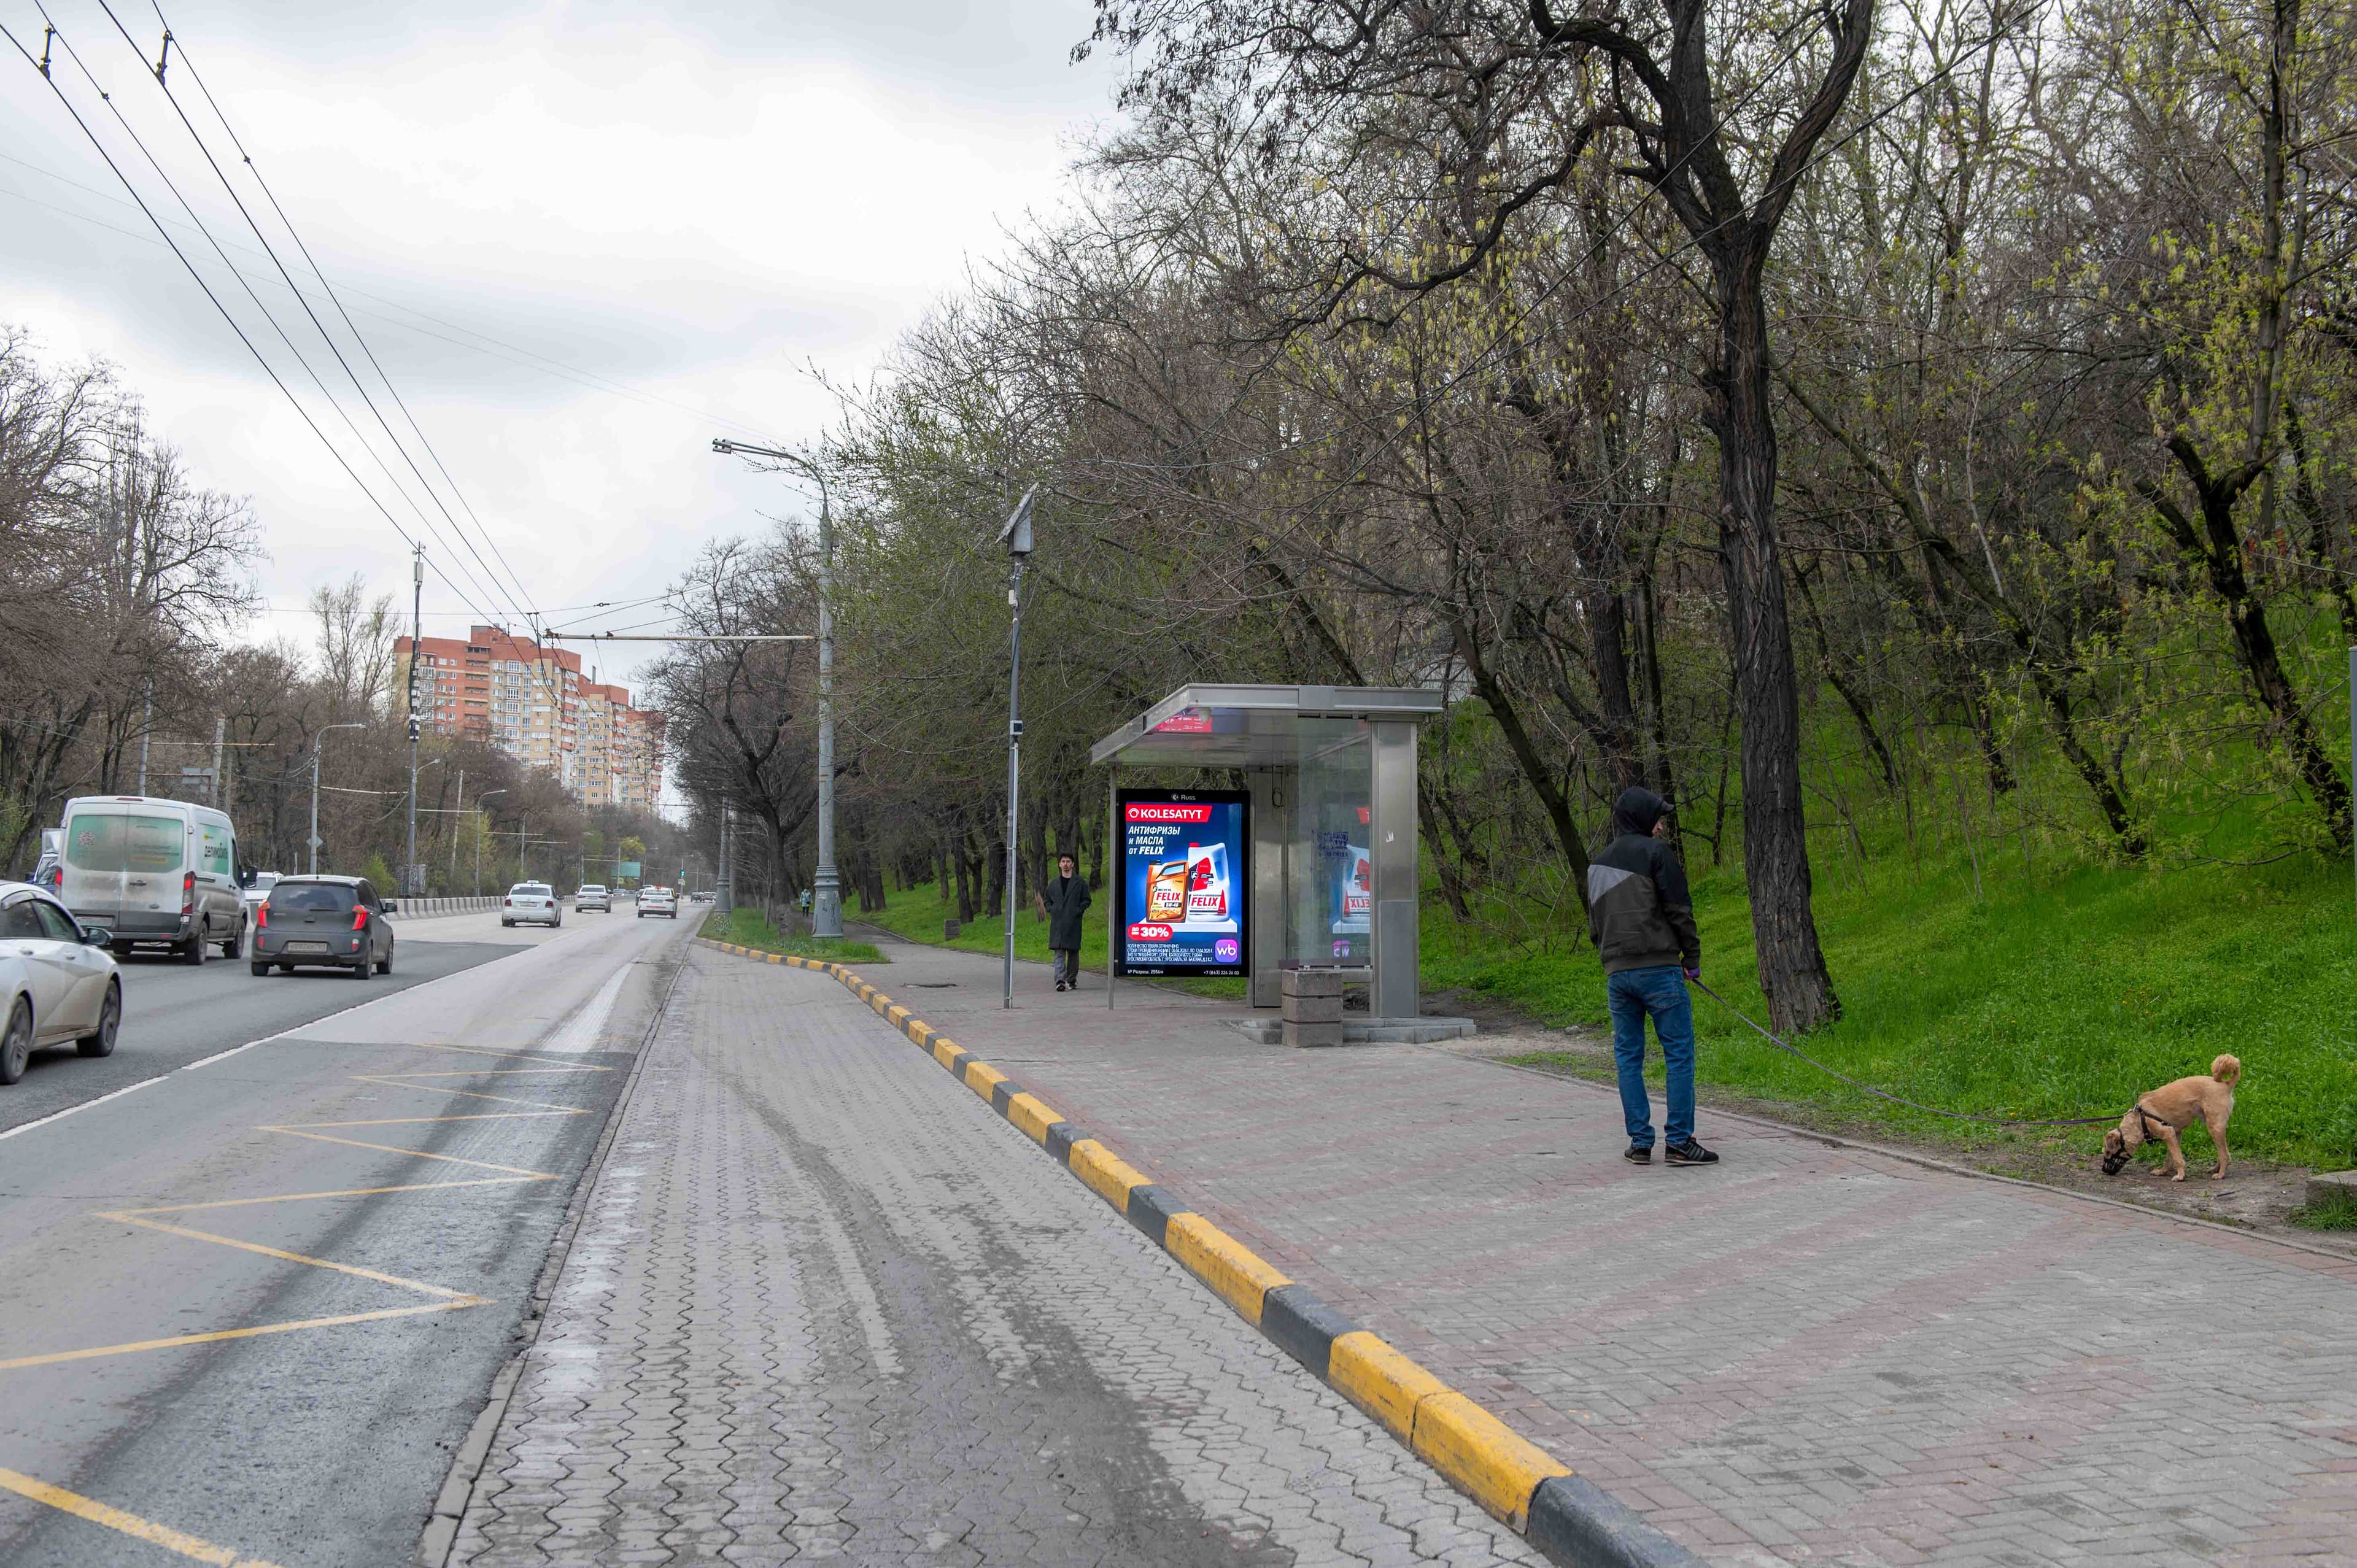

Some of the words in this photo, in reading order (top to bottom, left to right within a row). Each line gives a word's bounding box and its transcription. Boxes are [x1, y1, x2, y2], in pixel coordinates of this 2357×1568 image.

[1140, 809, 1202, 819] KOLESATYT
[1128, 826, 1180, 835] АНТИФРИЗЫ
[1136, 836, 1164, 845] МАСЛА
[1139, 846, 1164, 855] FELIX
[1191, 897, 1218, 906] FELIX
[1217, 944, 1236, 956] wb
